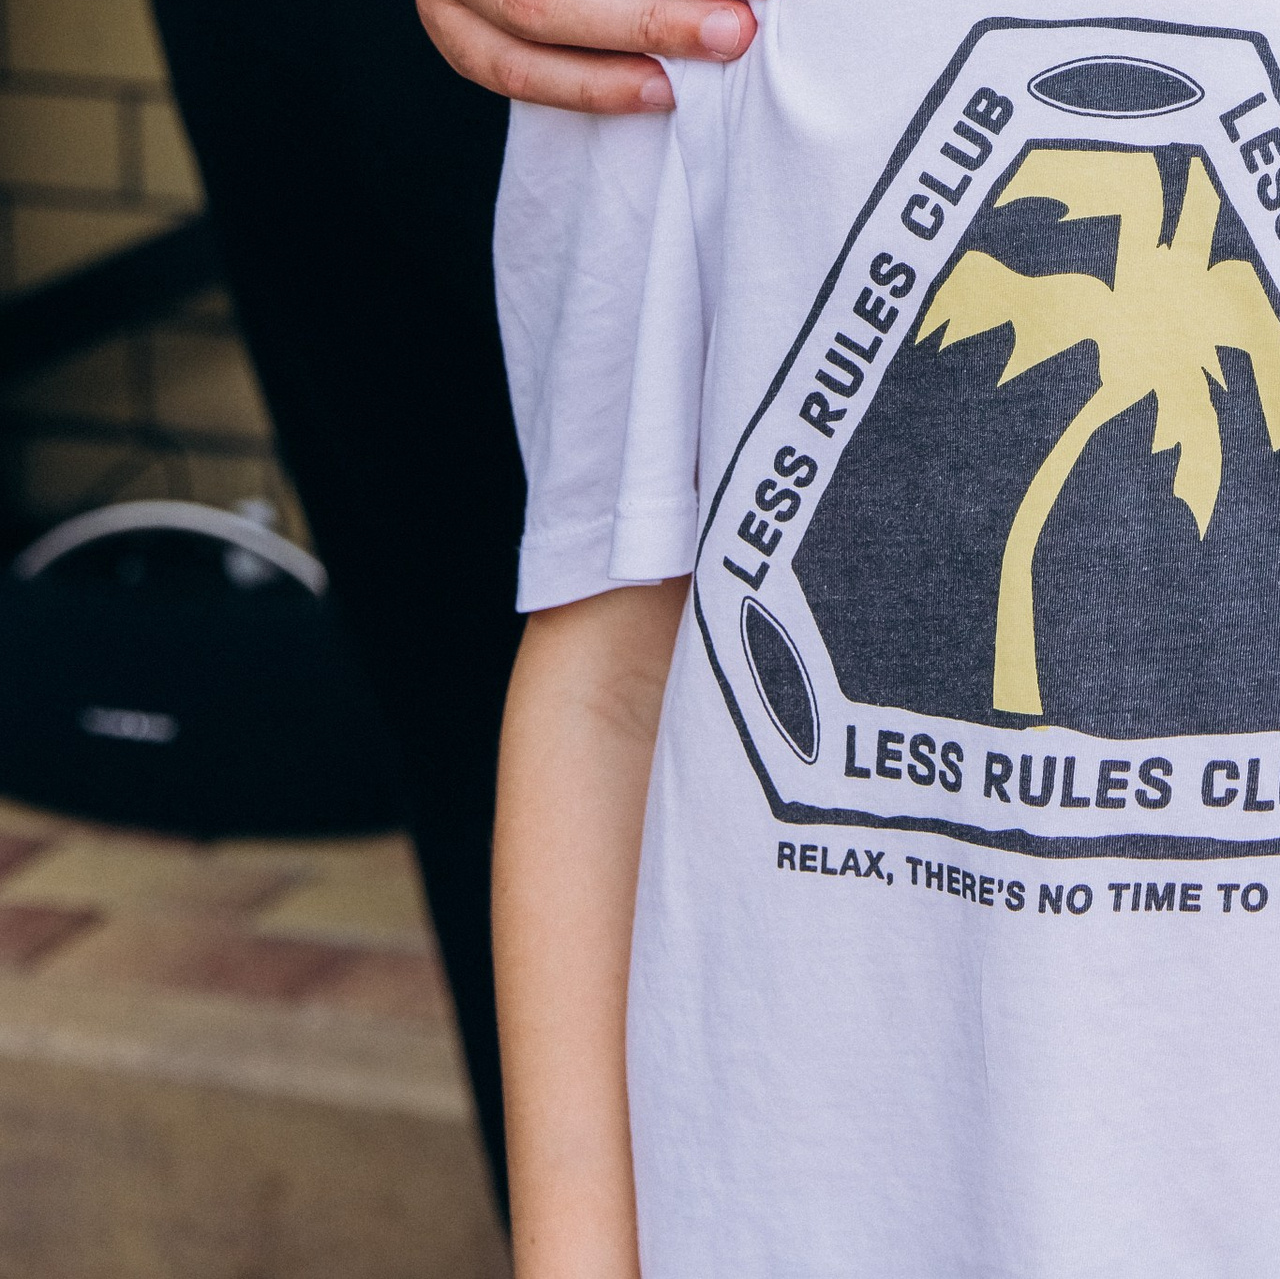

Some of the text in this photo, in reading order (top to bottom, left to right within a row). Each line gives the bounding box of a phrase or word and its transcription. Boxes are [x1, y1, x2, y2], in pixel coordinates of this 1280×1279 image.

[721, 86, 1015, 592] LESS RULES CLUB
[843, 723, 965, 794] LESS
[982, 750, 1174, 811] RULES
[776, 841, 894, 887] RELAX,
[904, 854, 1027, 913] THERE'S
[1037, 883, 1094, 915] NO
[1107, 882, 1203, 913] TIME
[1216, 882, 1269, 913] TO
